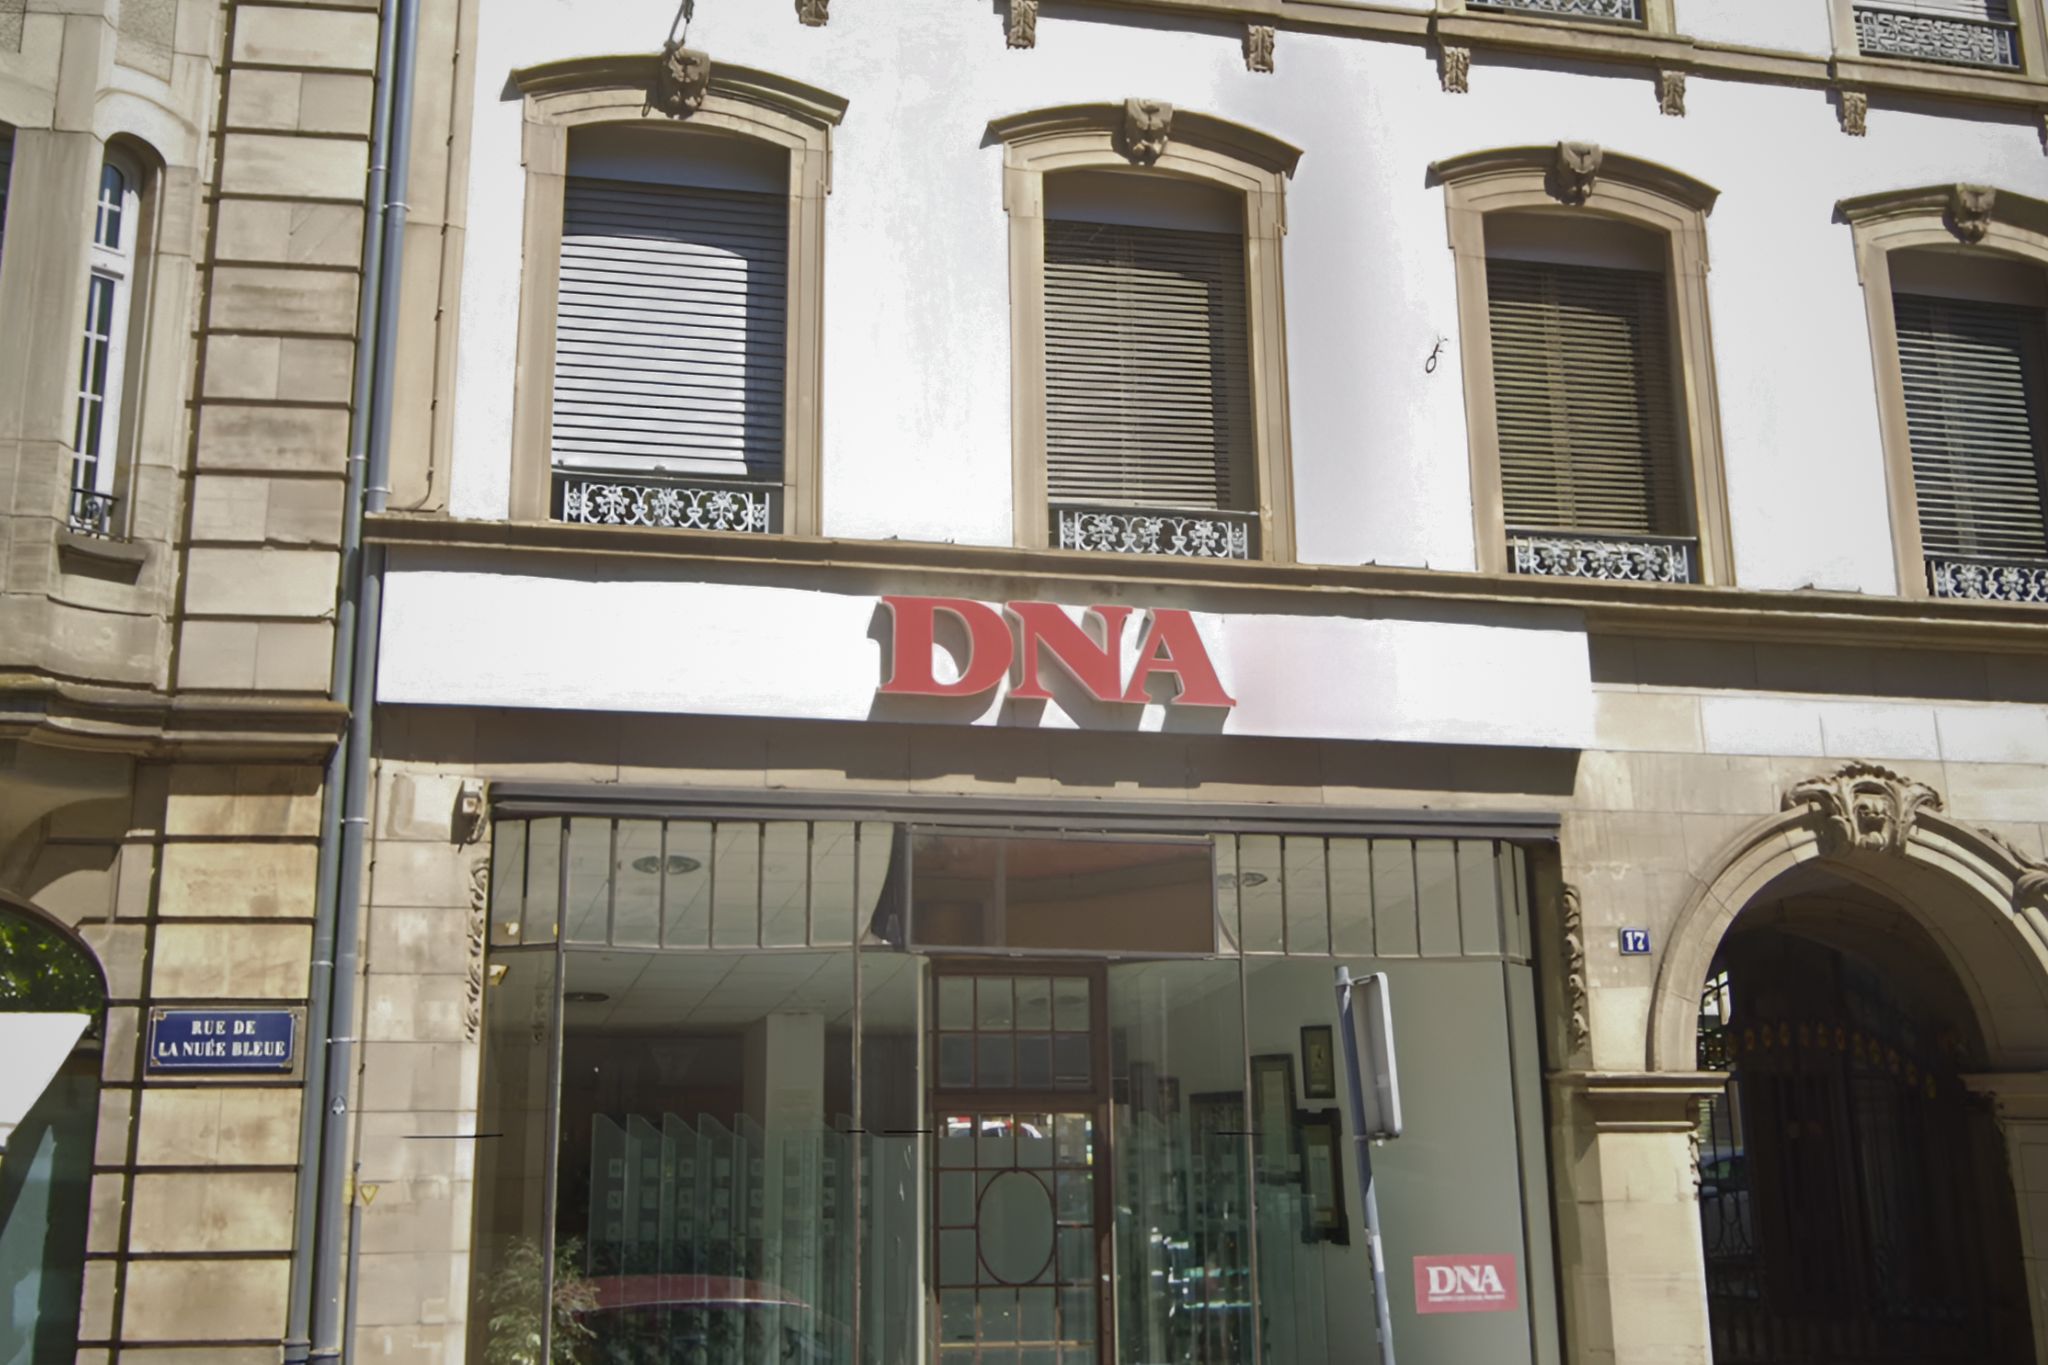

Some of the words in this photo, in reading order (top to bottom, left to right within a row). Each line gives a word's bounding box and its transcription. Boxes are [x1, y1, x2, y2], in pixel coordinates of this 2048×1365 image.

[877, 596, 1237, 707] DNA
[1625, 931, 1645, 950] 17
[191, 1020, 226, 1035] RUE
[233, 1020, 256, 1035] DE
[158, 1042, 178, 1057] LA
[182, 1038, 226, 1057] NUÉE
[231, 1041, 285, 1057] BLEUE
[1425, 1264, 1505, 1294] DNA
